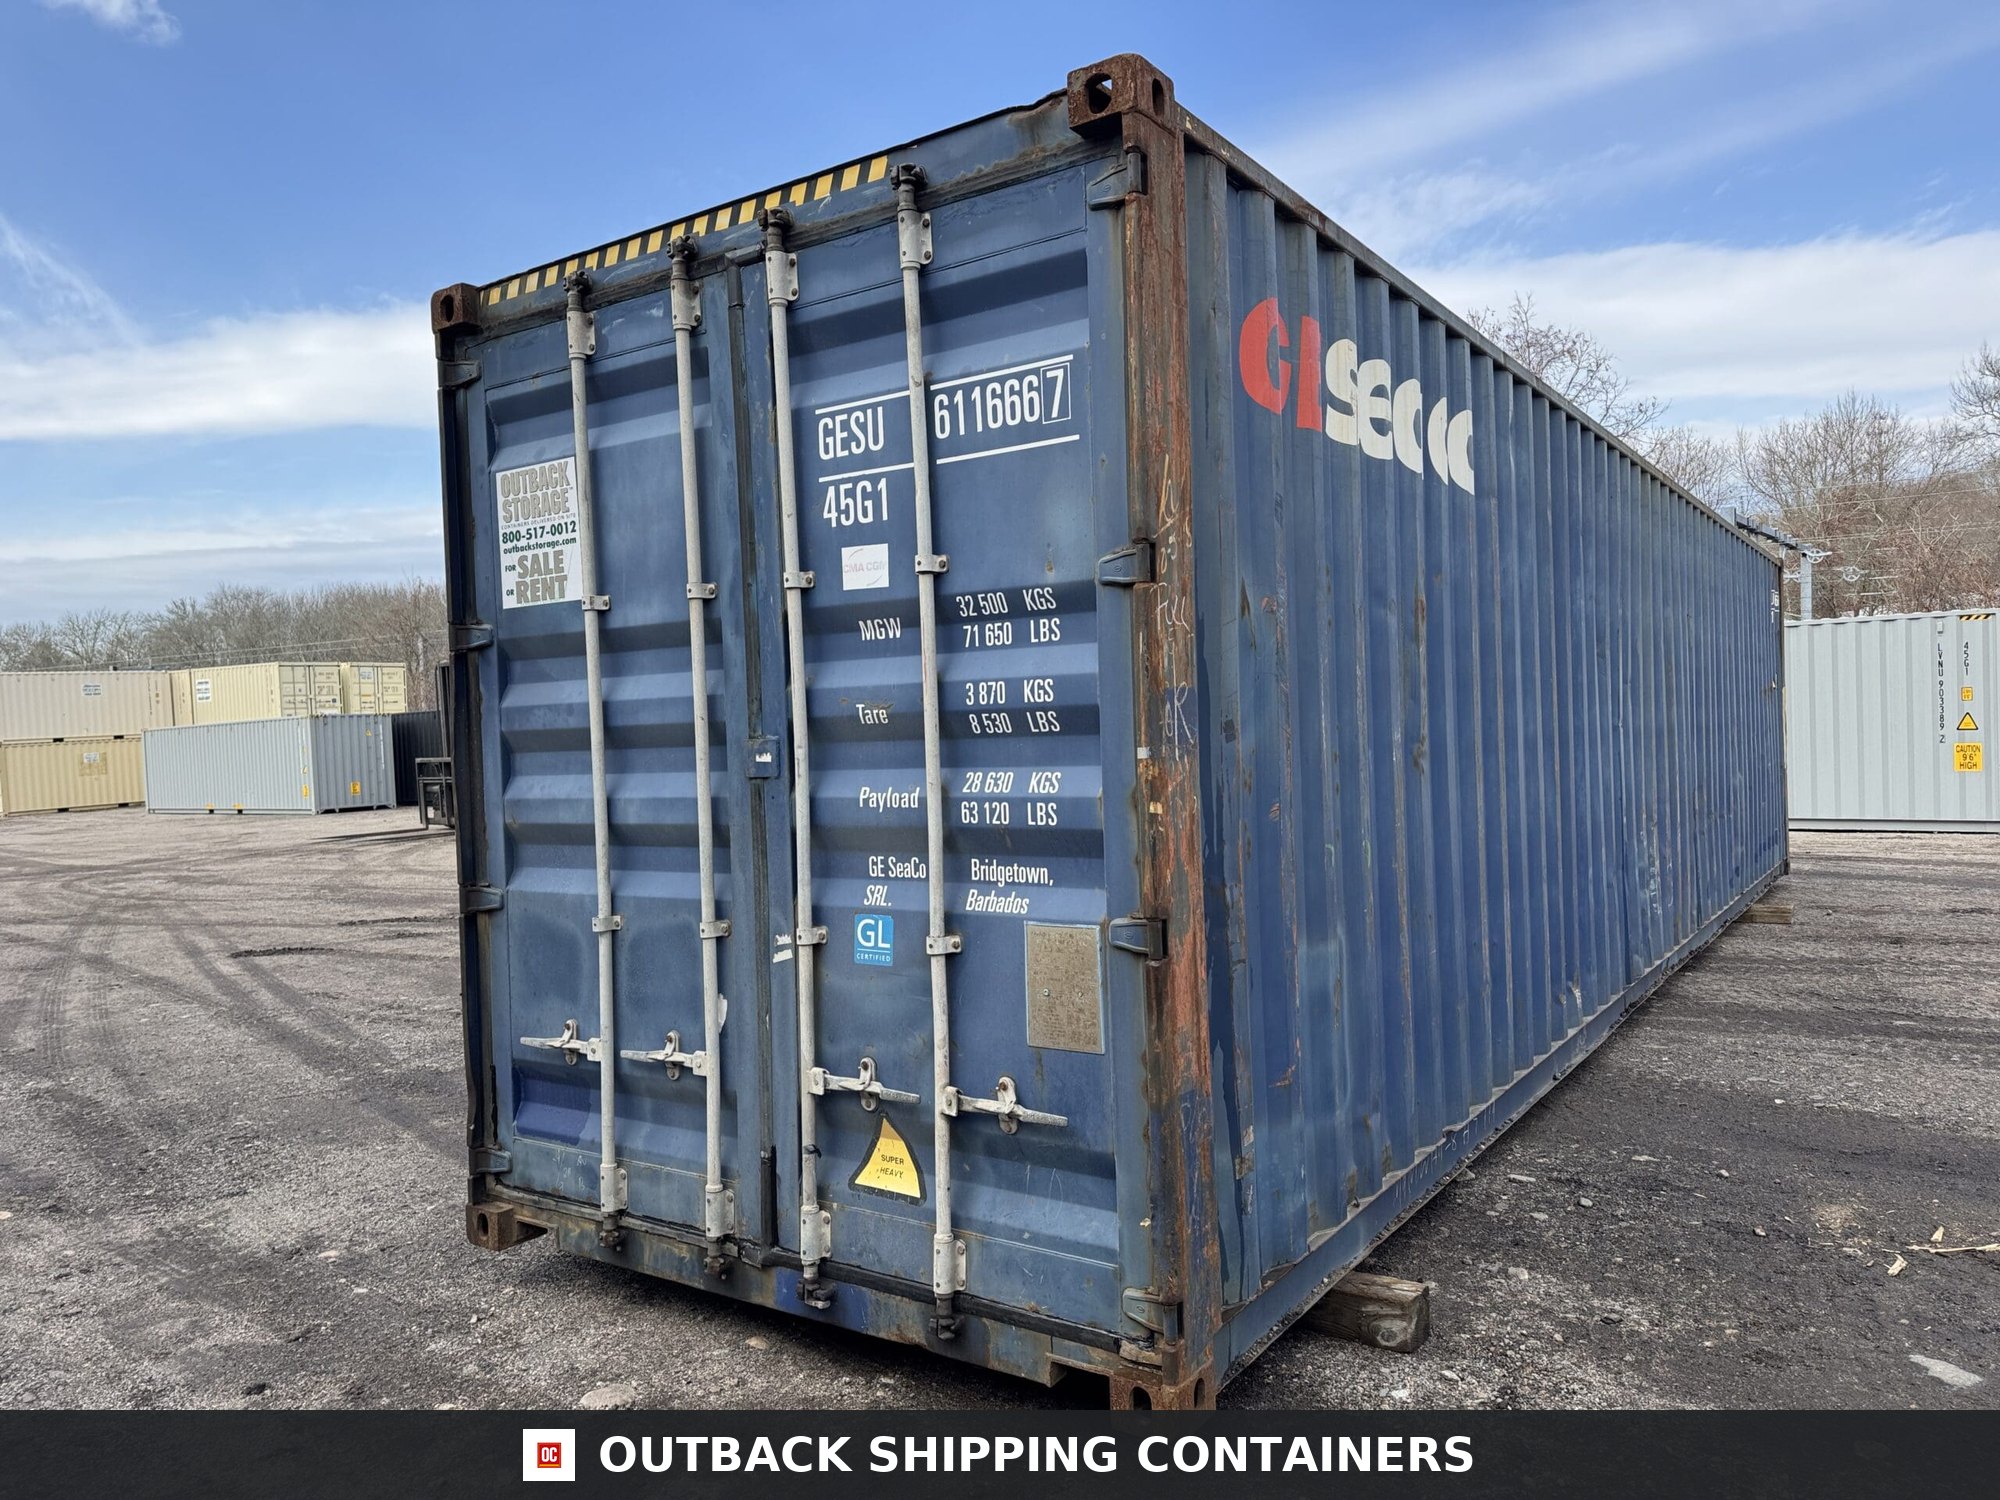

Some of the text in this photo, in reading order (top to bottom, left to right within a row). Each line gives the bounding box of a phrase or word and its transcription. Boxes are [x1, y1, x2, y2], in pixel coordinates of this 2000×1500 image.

[818, 368, 1064, 461] GESU 611666 7
[500, 460, 571, 499] OUTBACK
[502, 488, 571, 524] STORAGE
[823, 477, 888, 528] 45G1
[502, 520, 577, 544] 800-517-0012
[503, 537, 577, 554] outbackstorage.com
[505, 549, 565, 579] FOR SALE
[506, 574, 568, 604] OR RENT
[956, 587, 1057, 617] 32 500 KGS
[858, 616, 902, 641] MGW
[963, 617, 1061, 648] 71 650 LBS
[965, 679, 1054, 705] 3 870 KGS
[856, 703, 889, 725] Tare
[969, 711, 1061, 734] 8 530 LBS
[1955, 745, 1981, 753] CAUTION
[1959, 762, 1978, 770] HIGH
[962, 771, 1061, 794] 28 630 KGS
[859, 786, 920, 812] Payload
[961, 801, 1058, 826] 63 120 LBS
[868, 855, 927, 879] GE SeaCo
[971, 858, 1054, 887] Bridgetown,
[863, 885, 892, 907] SRL.
[966, 889, 1030, 915] Barbados
[857, 918, 891, 948] GL
[856, 953, 891, 962] CERTIFIED
[881, 1154, 905, 1165] SUPER
[880, 1167, 904, 1179] HEAVY
